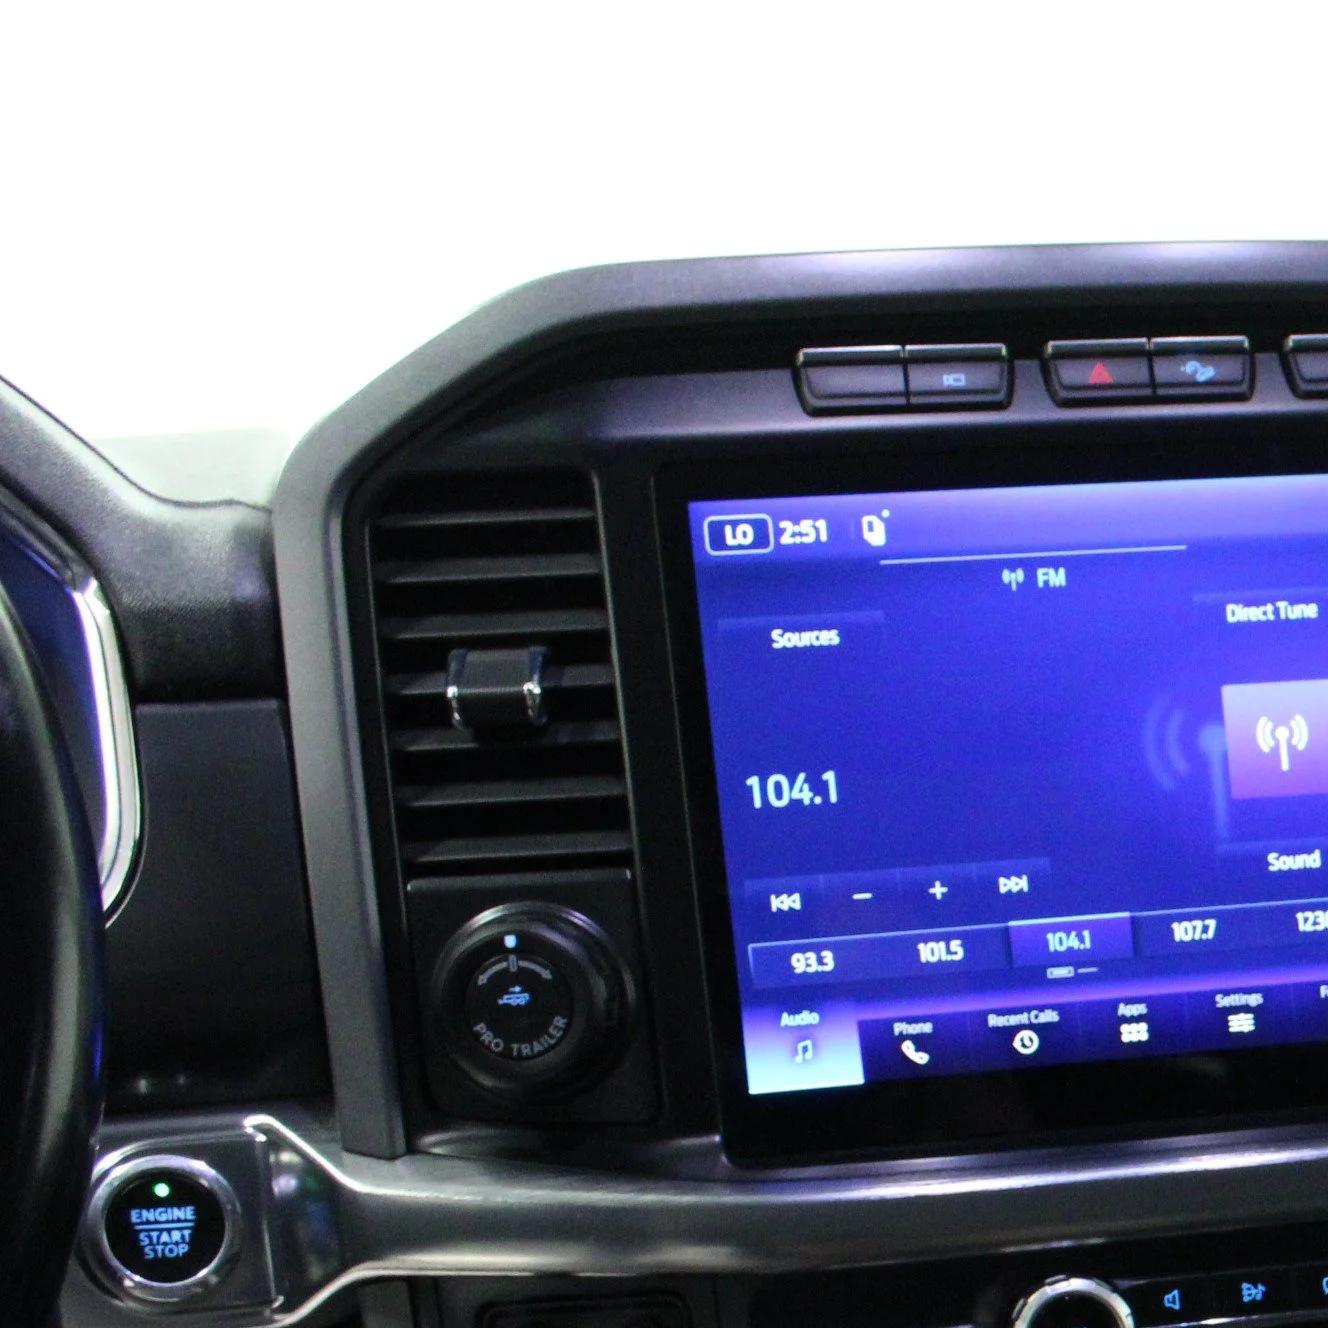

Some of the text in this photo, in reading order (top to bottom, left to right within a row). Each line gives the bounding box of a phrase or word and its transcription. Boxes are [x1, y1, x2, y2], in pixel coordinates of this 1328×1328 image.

[724, 523, 754, 547] LO
[779, 519, 829, 545] 2:51
[1037, 567, 1067, 588] FM
[1226, 600, 1319, 623] Direct Tune
[771, 627, 841, 650] Sources
[745, 770, 839, 810] 104.1
[1267, 849, 1322, 872] Sound
[1046, 930, 1092, 953] 104.1
[1171, 919, 1217, 943] 107.7
[790, 950, 835, 974] 93.3
[917, 940, 965, 964] 101.5
[1117, 1002, 1148, 1020] Apps
[1215, 992, 1264, 1010] Settings
[780, 1009, 820, 1028] Audio
[893, 1020, 934, 1037] Phone
[988, 1009, 1059, 1029] Recent Calls
[473, 1016, 568, 1058] PRO TRAILER
[130, 1205, 197, 1223] ENGINE
[138, 1229, 193, 1246] START
[144, 1244, 190, 1259] STOP
